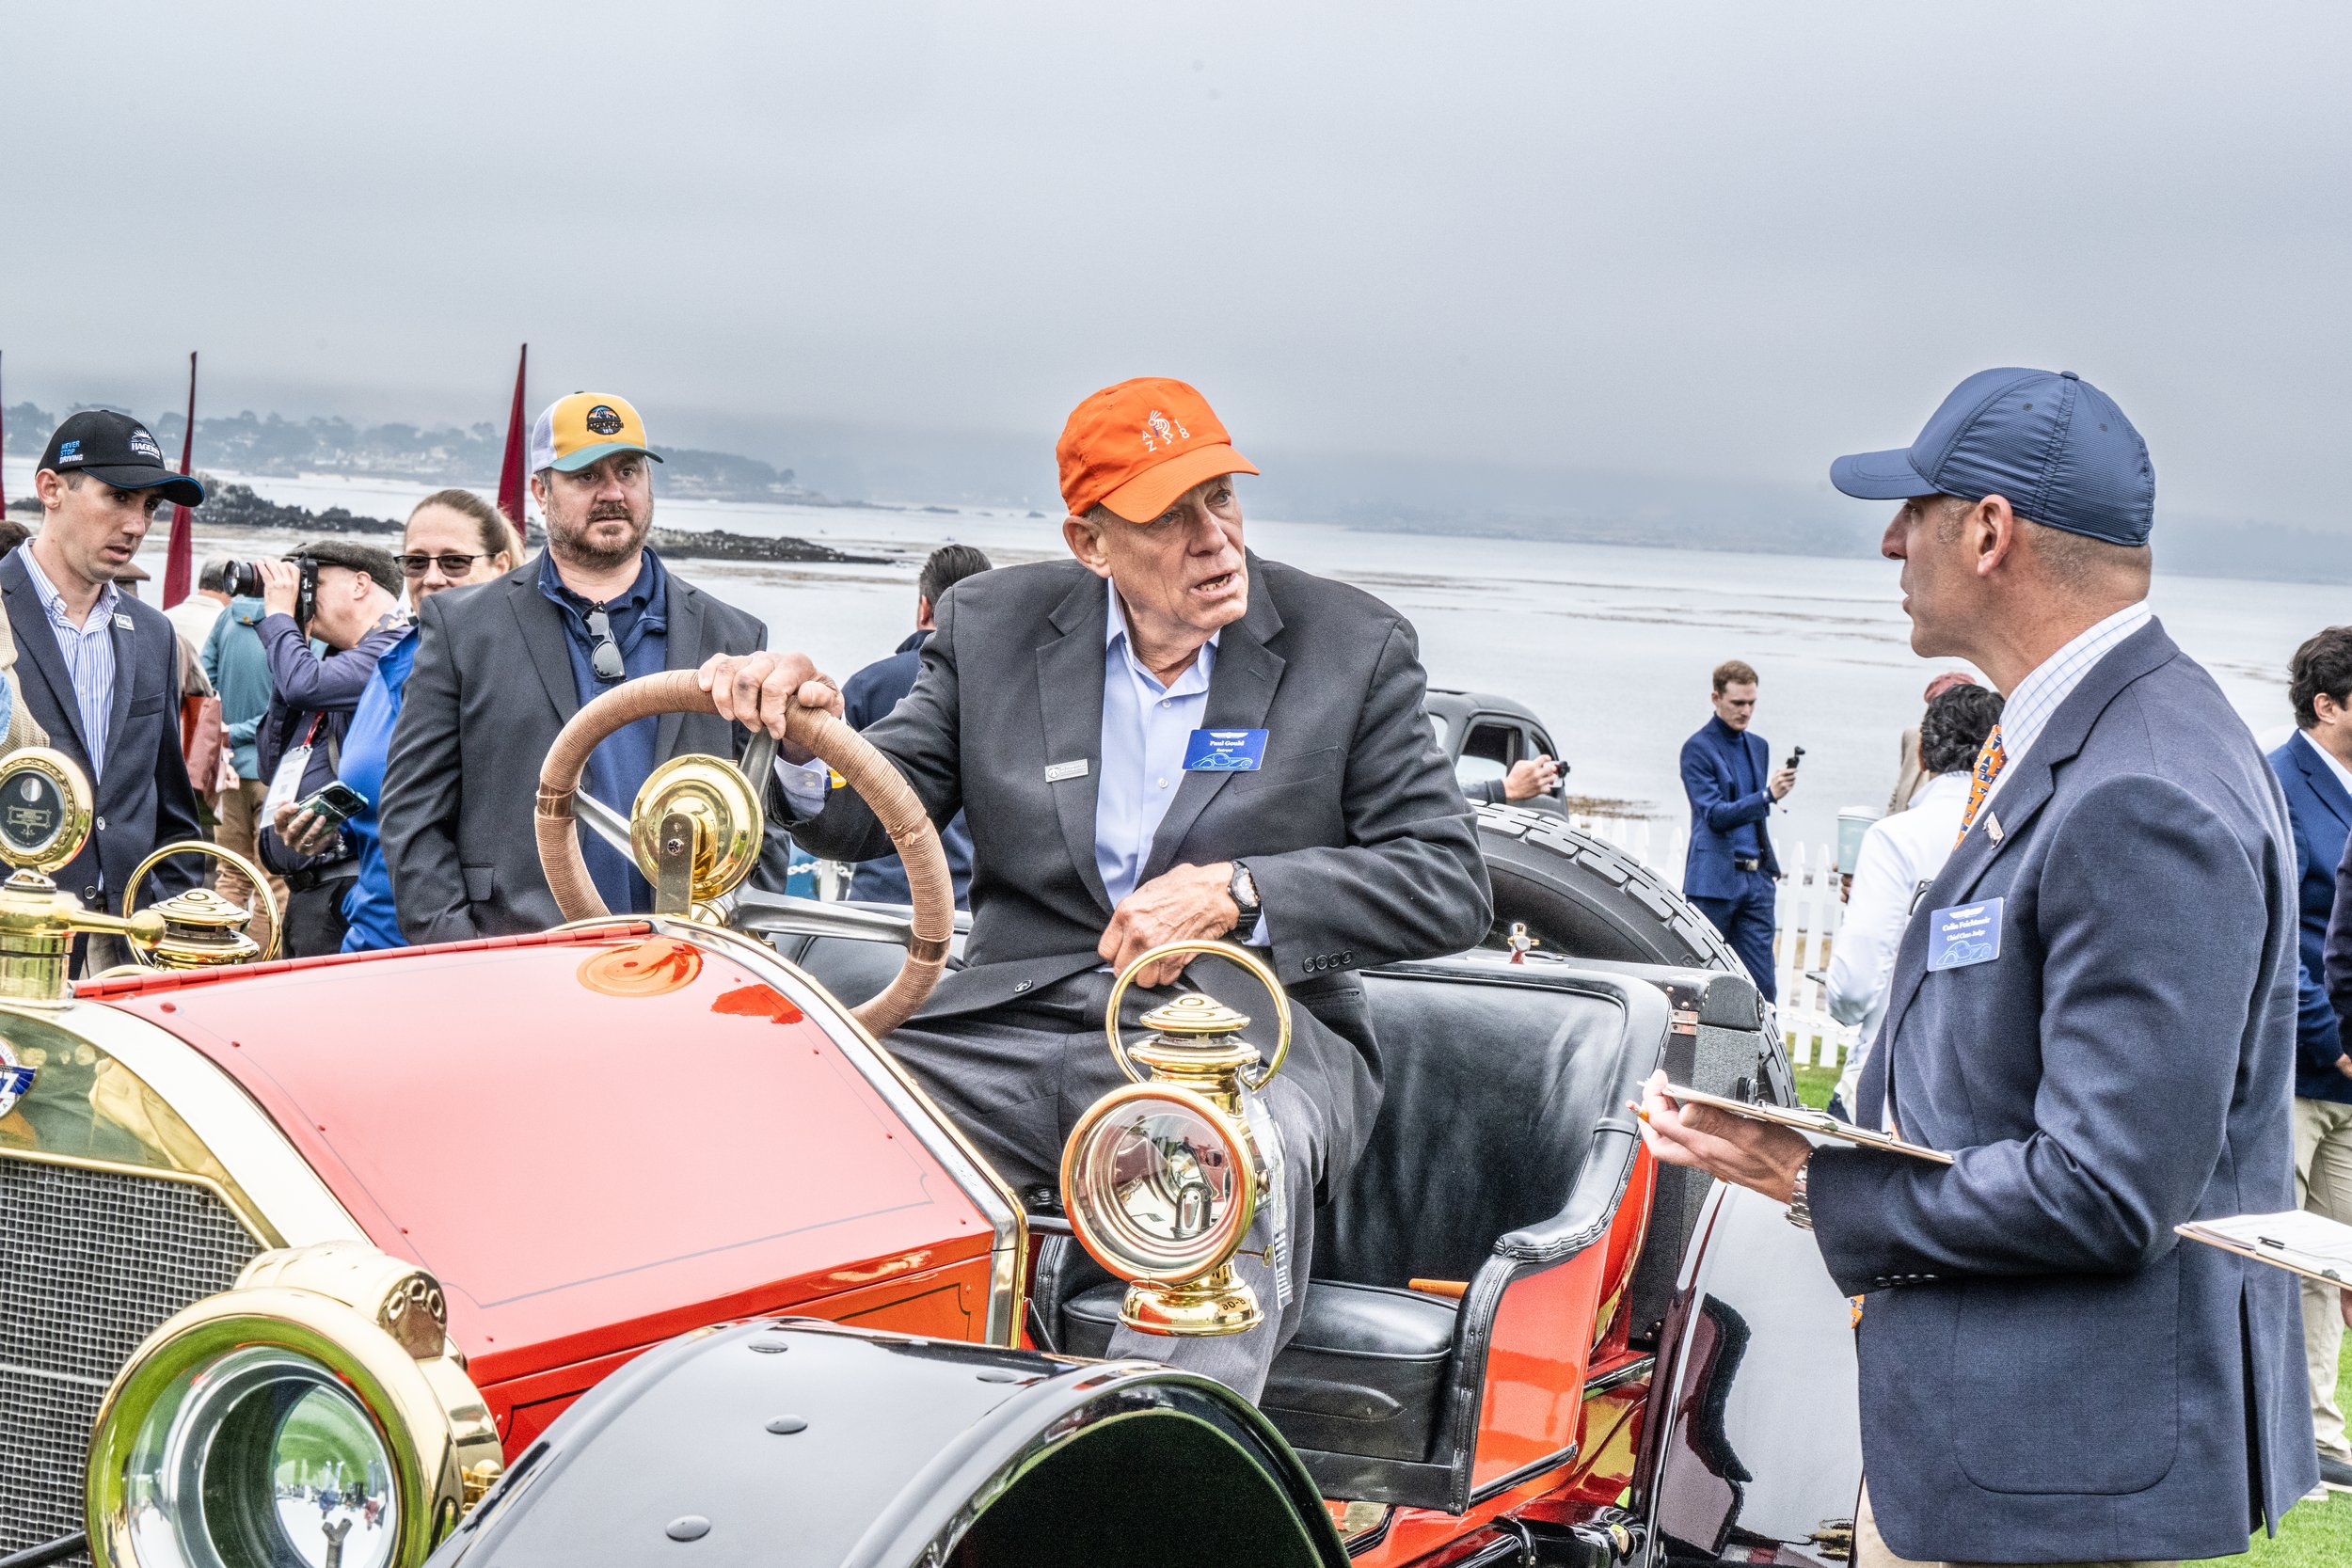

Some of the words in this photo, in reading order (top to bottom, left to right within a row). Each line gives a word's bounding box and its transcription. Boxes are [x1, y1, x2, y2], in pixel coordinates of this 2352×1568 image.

[61, 440, 80, 450] NEVER
[60, 448, 76, 457] STOP
[59, 453, 84, 464] DRIVING
